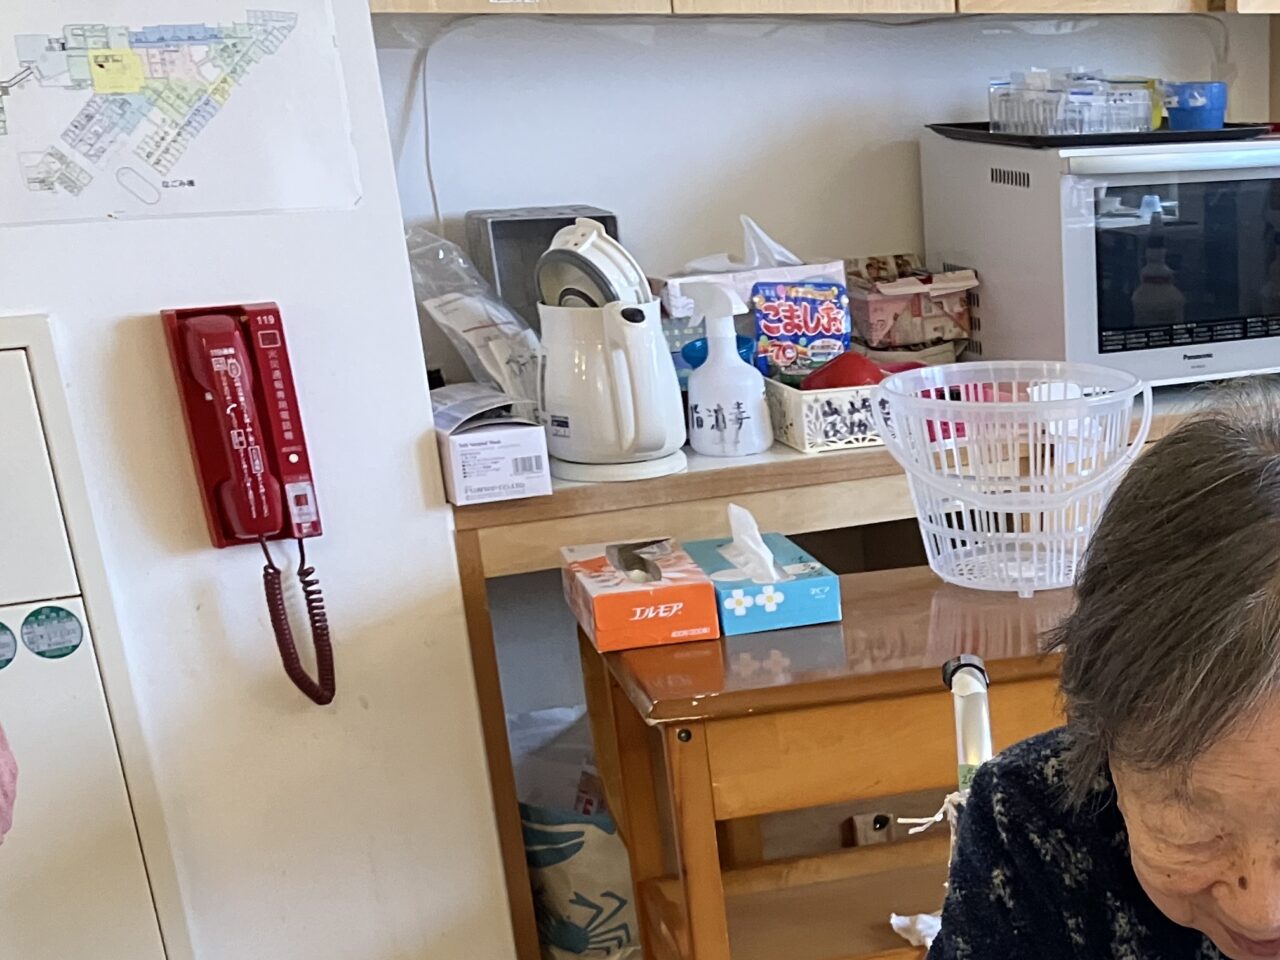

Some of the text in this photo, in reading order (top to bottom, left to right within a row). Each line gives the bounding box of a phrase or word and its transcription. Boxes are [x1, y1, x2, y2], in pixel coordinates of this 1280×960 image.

[256, 314, 275, 324] 119
[630, 602, 684, 621] エルモア
